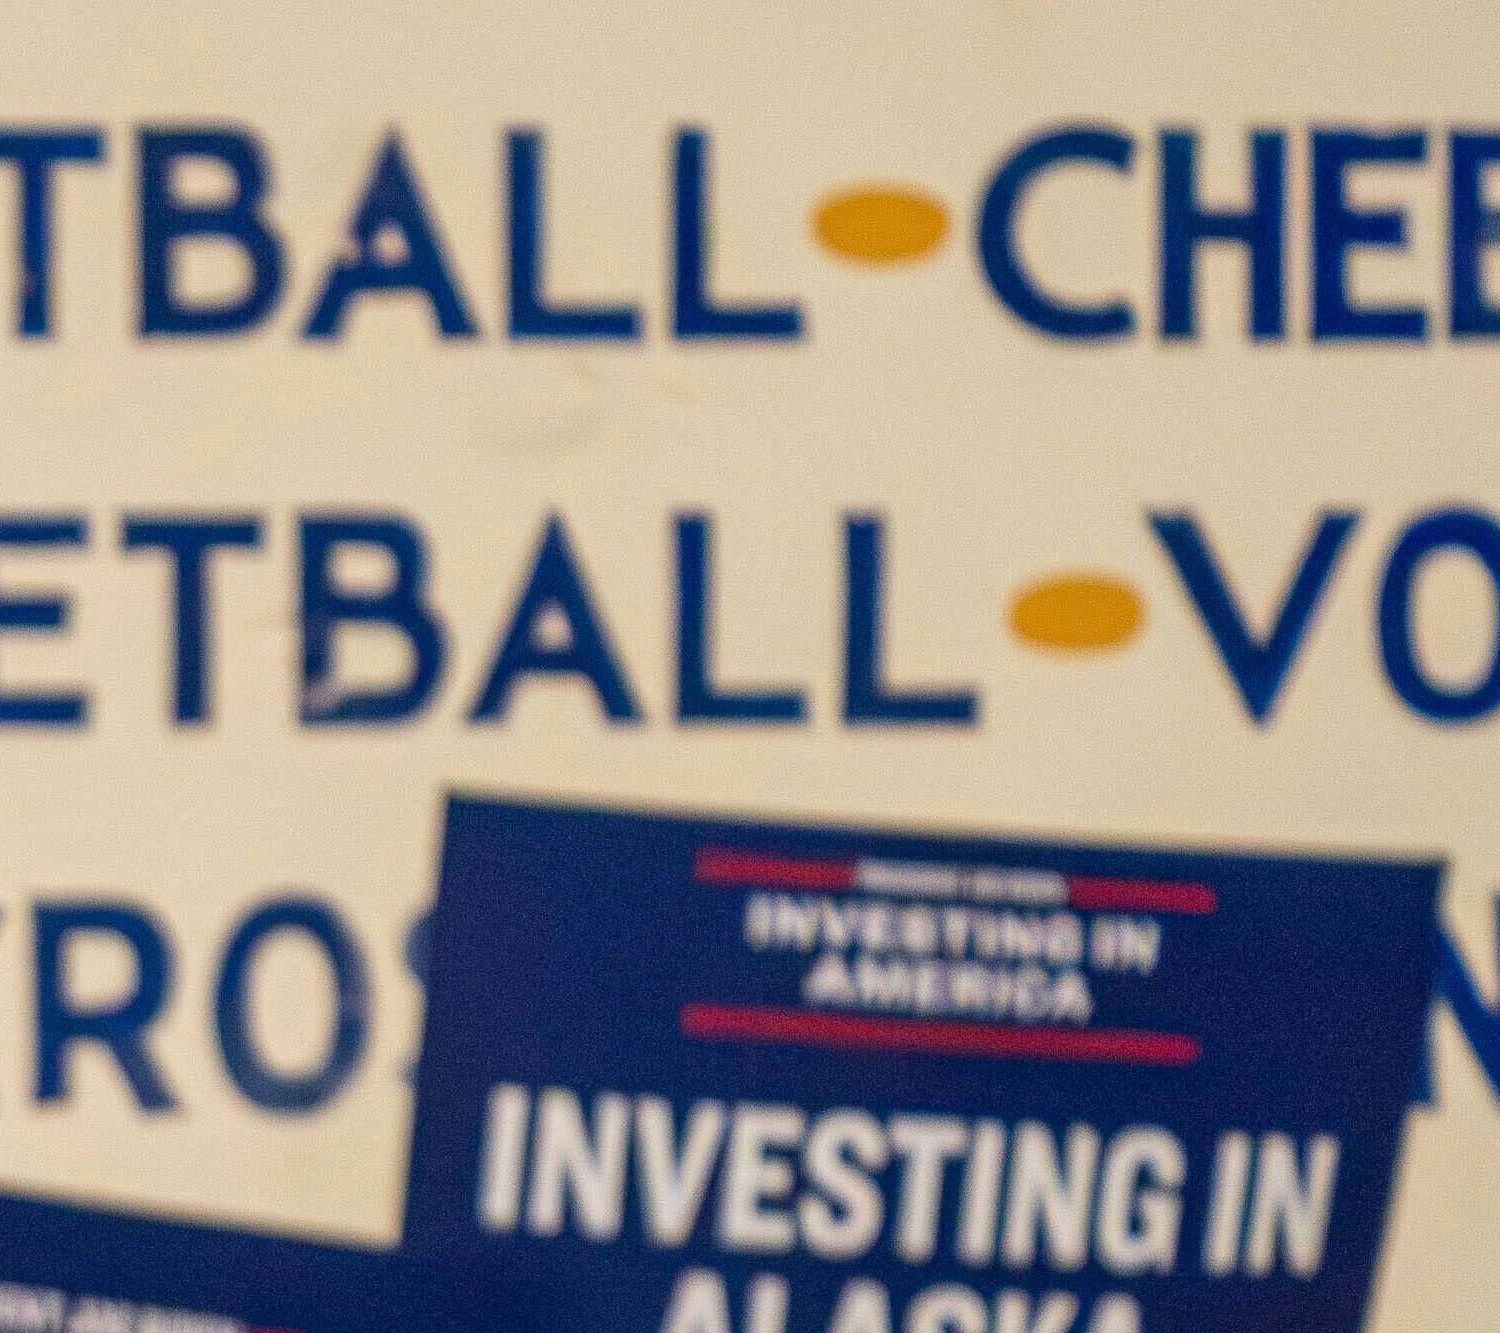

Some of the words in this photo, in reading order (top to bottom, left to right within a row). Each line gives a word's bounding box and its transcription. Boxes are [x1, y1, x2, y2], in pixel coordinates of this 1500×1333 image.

[1147, 504, 1500, 729] VO
[744, 890, 1082, 968] INVESTING
[1090, 917, 1161, 972] IN
[803, 955, 1092, 1021] AMERICA
[478, 1082, 1186, 1273] INVESTING
[1203, 1130, 1340, 1277] IN
